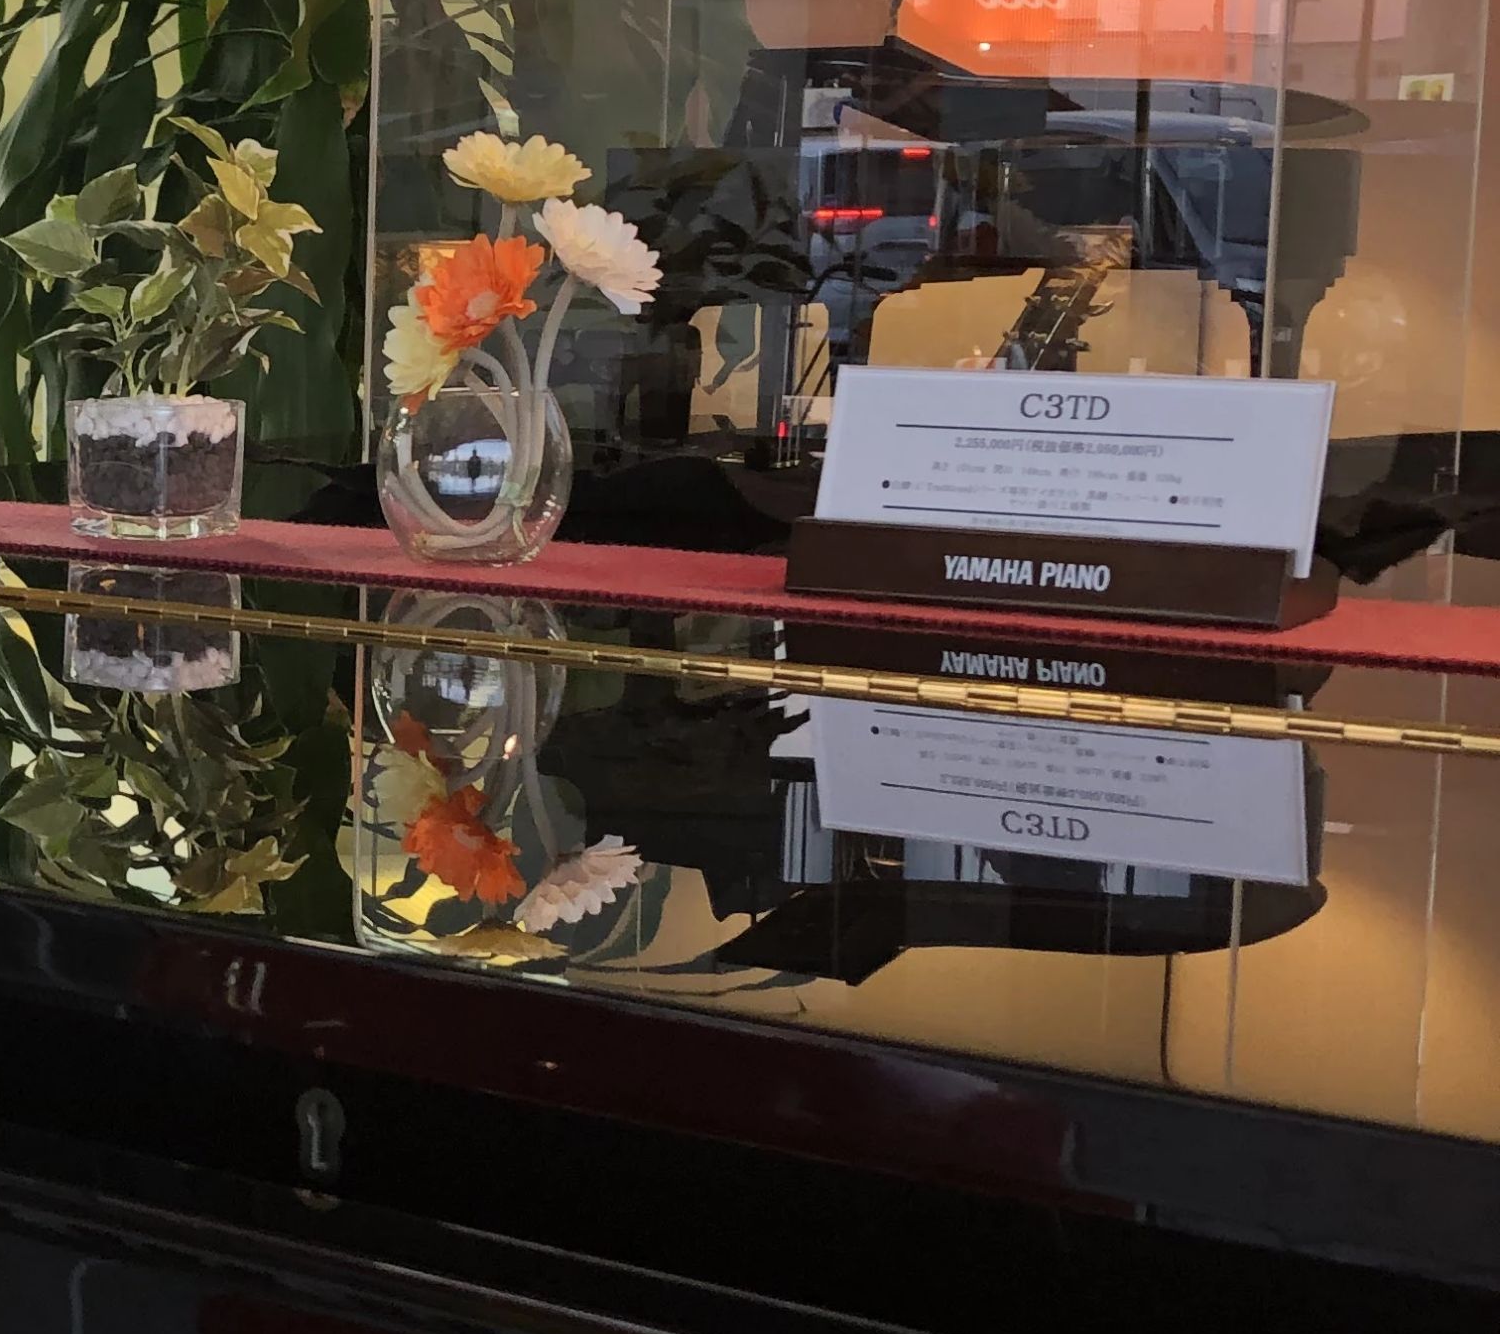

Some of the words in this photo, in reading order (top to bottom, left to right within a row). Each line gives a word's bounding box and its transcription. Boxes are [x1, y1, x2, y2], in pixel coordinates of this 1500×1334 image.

[1019, 393, 1111, 420] C3TD
[944, 555, 1033, 586] YAMAHA
[1039, 562, 1111, 592] PIANO
